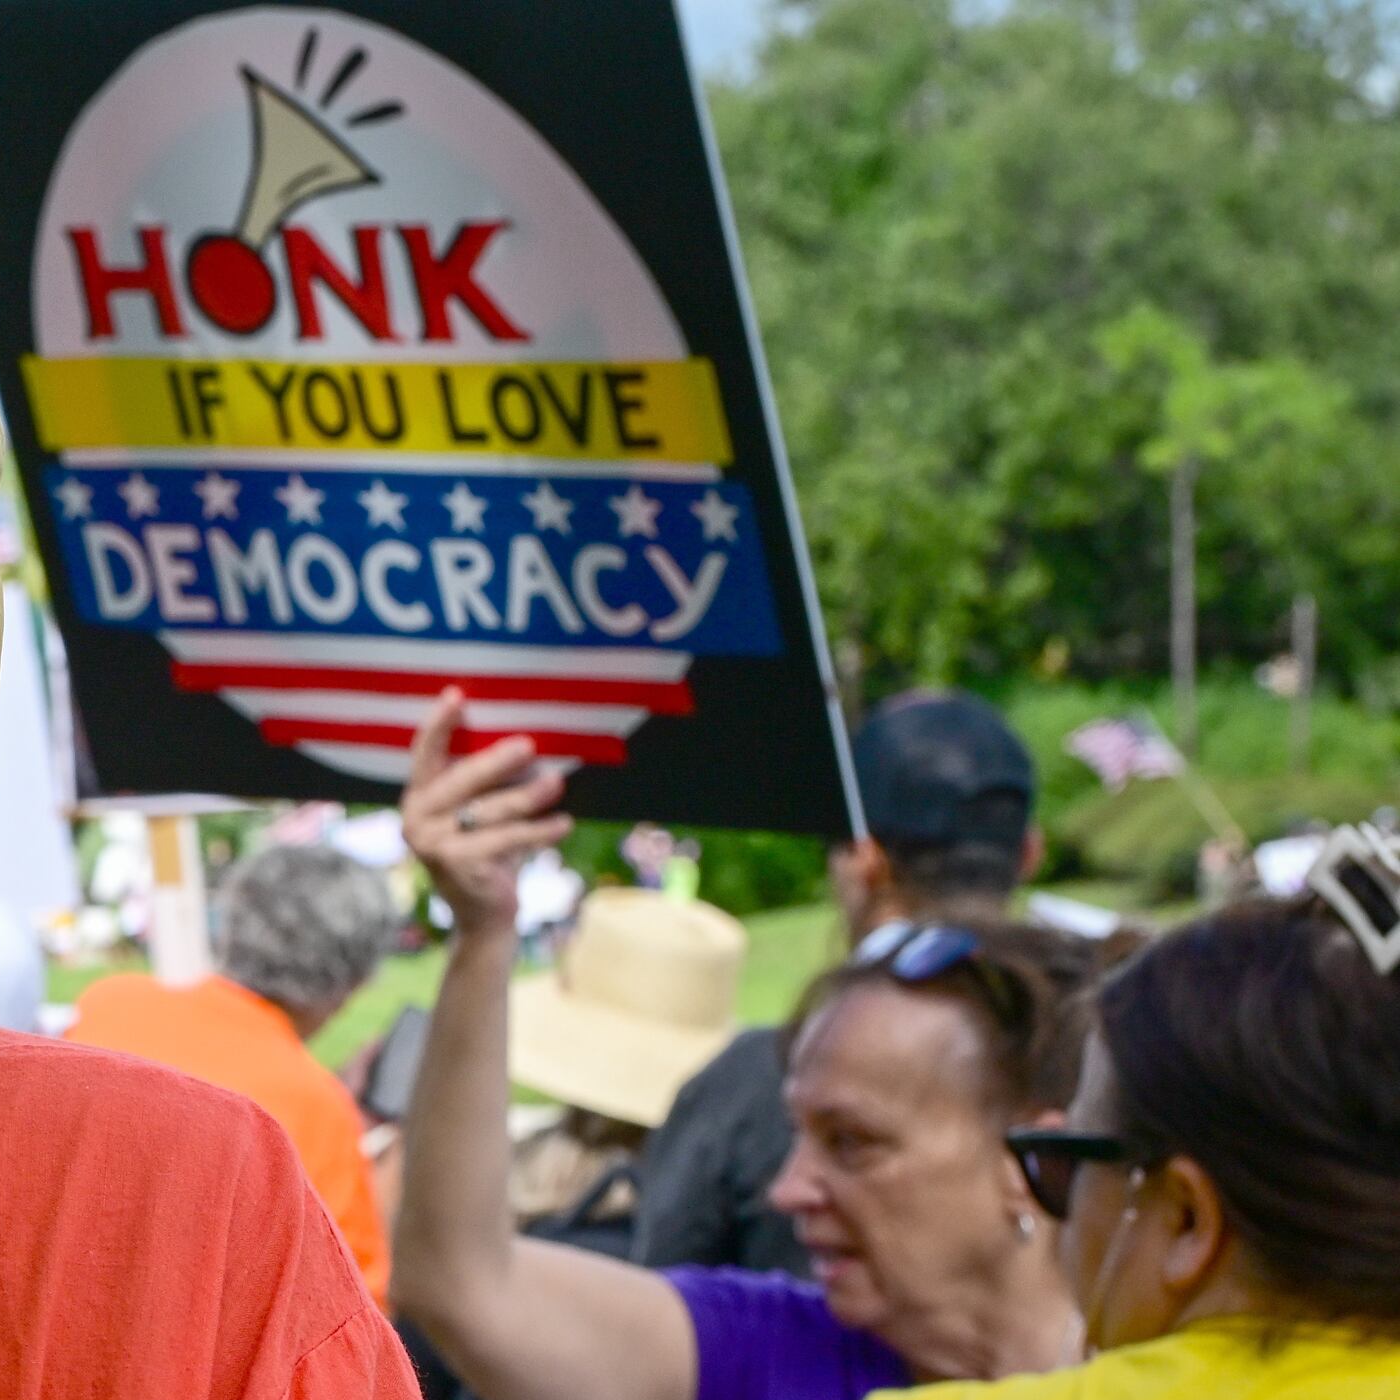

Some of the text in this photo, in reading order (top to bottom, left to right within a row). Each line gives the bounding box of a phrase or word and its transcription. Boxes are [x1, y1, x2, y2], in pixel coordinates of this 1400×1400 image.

[63, 219, 531, 345] HONK
[165, 366, 661, 450] IF YOU LOVE
[81, 521, 728, 642] DEMOCRACY
